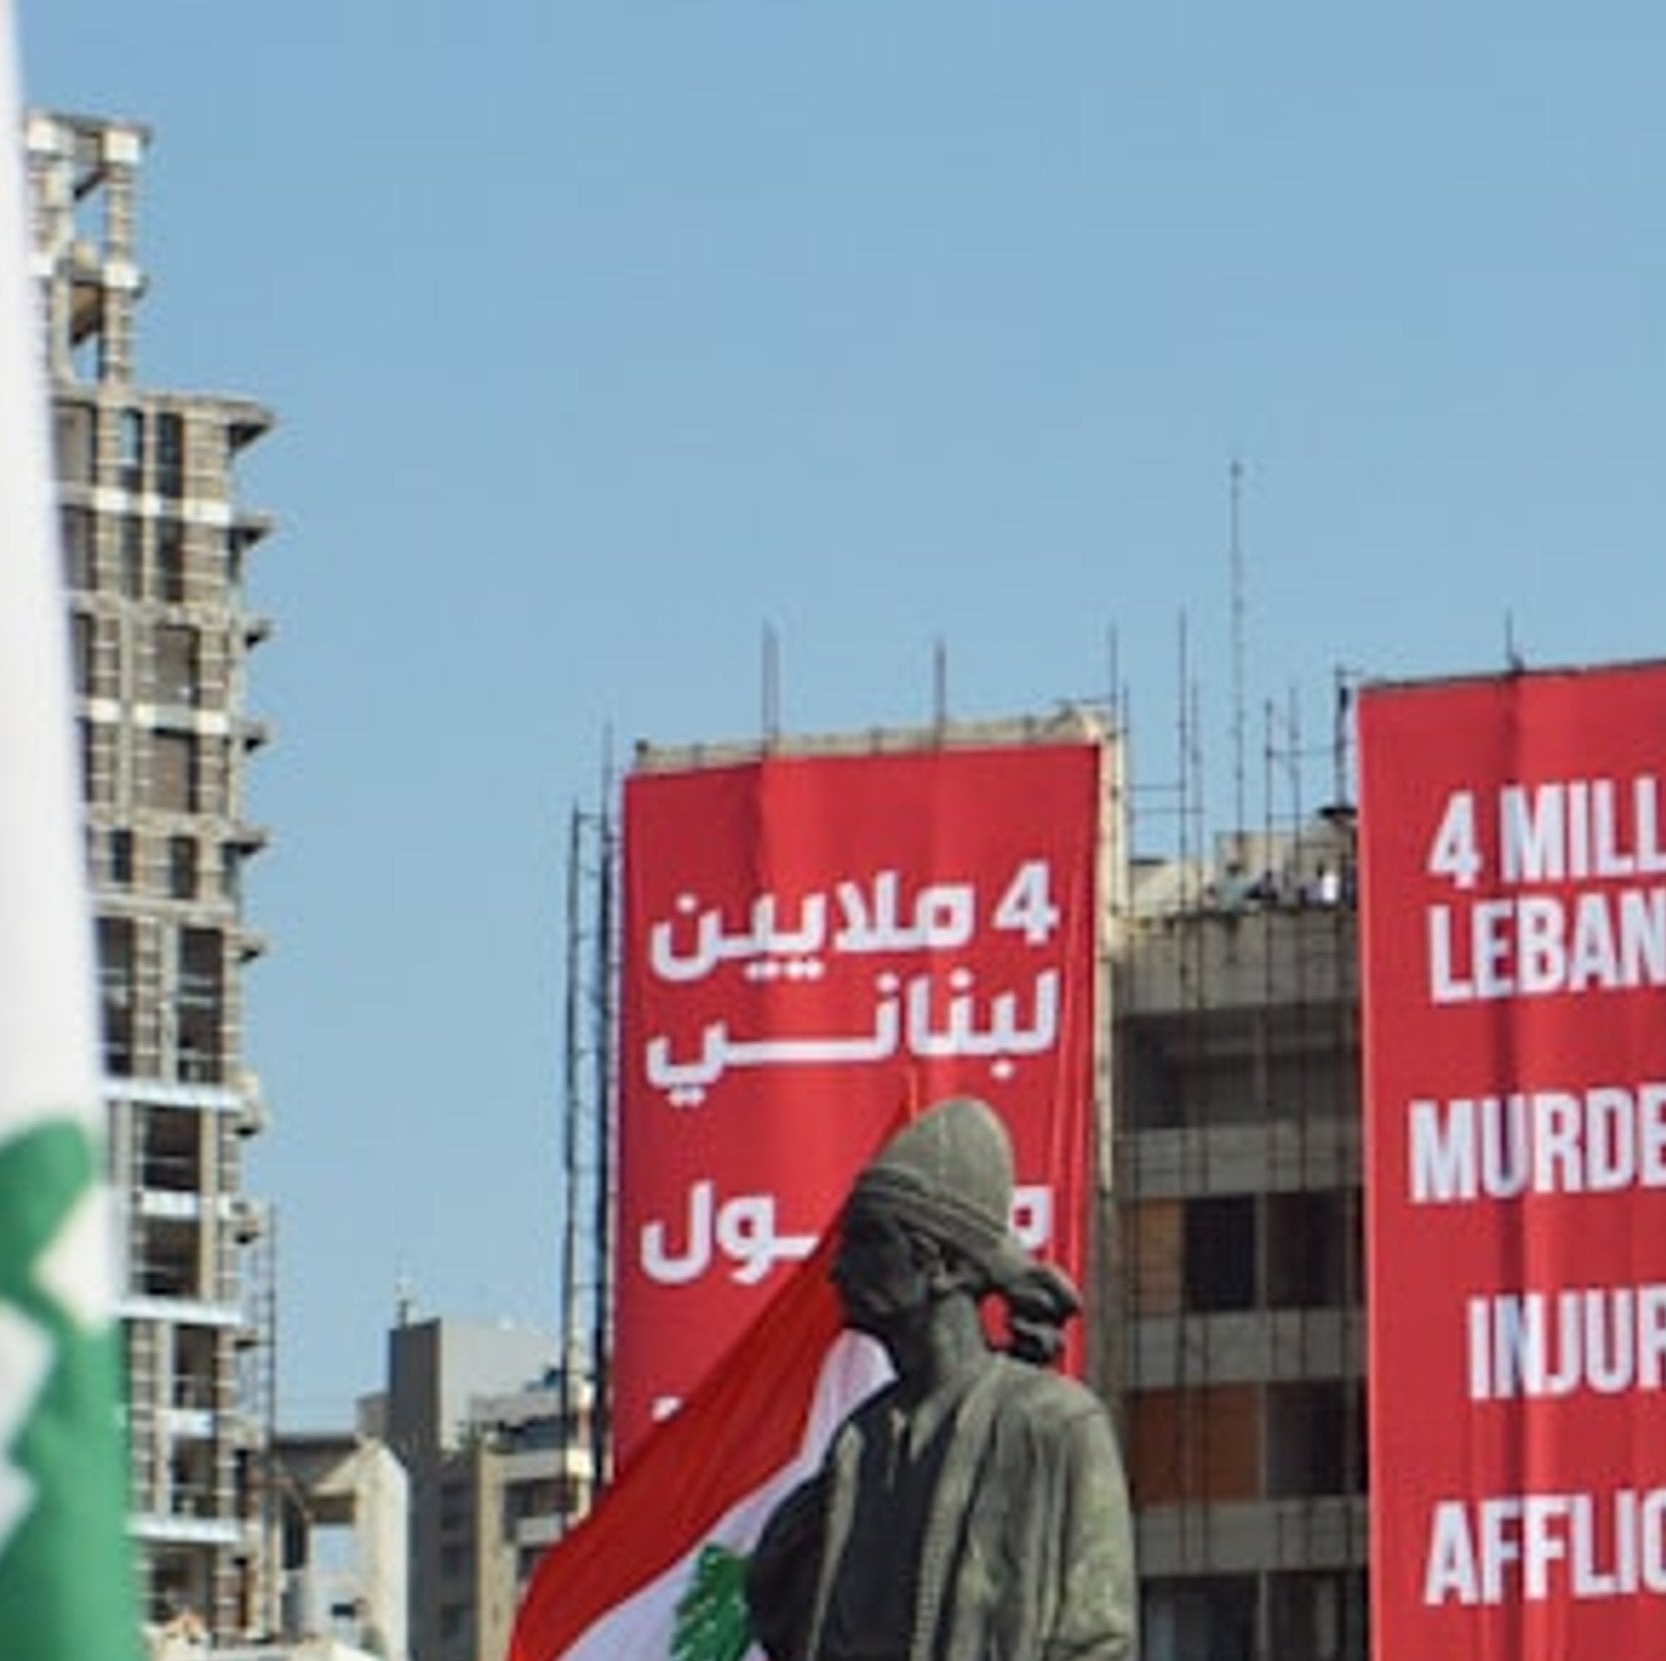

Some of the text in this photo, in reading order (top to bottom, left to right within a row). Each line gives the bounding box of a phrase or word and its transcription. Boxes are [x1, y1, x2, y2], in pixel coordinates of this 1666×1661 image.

[1429, 791, 1482, 888] 4
[650, 861, 1059, 981] 4 ملايين
